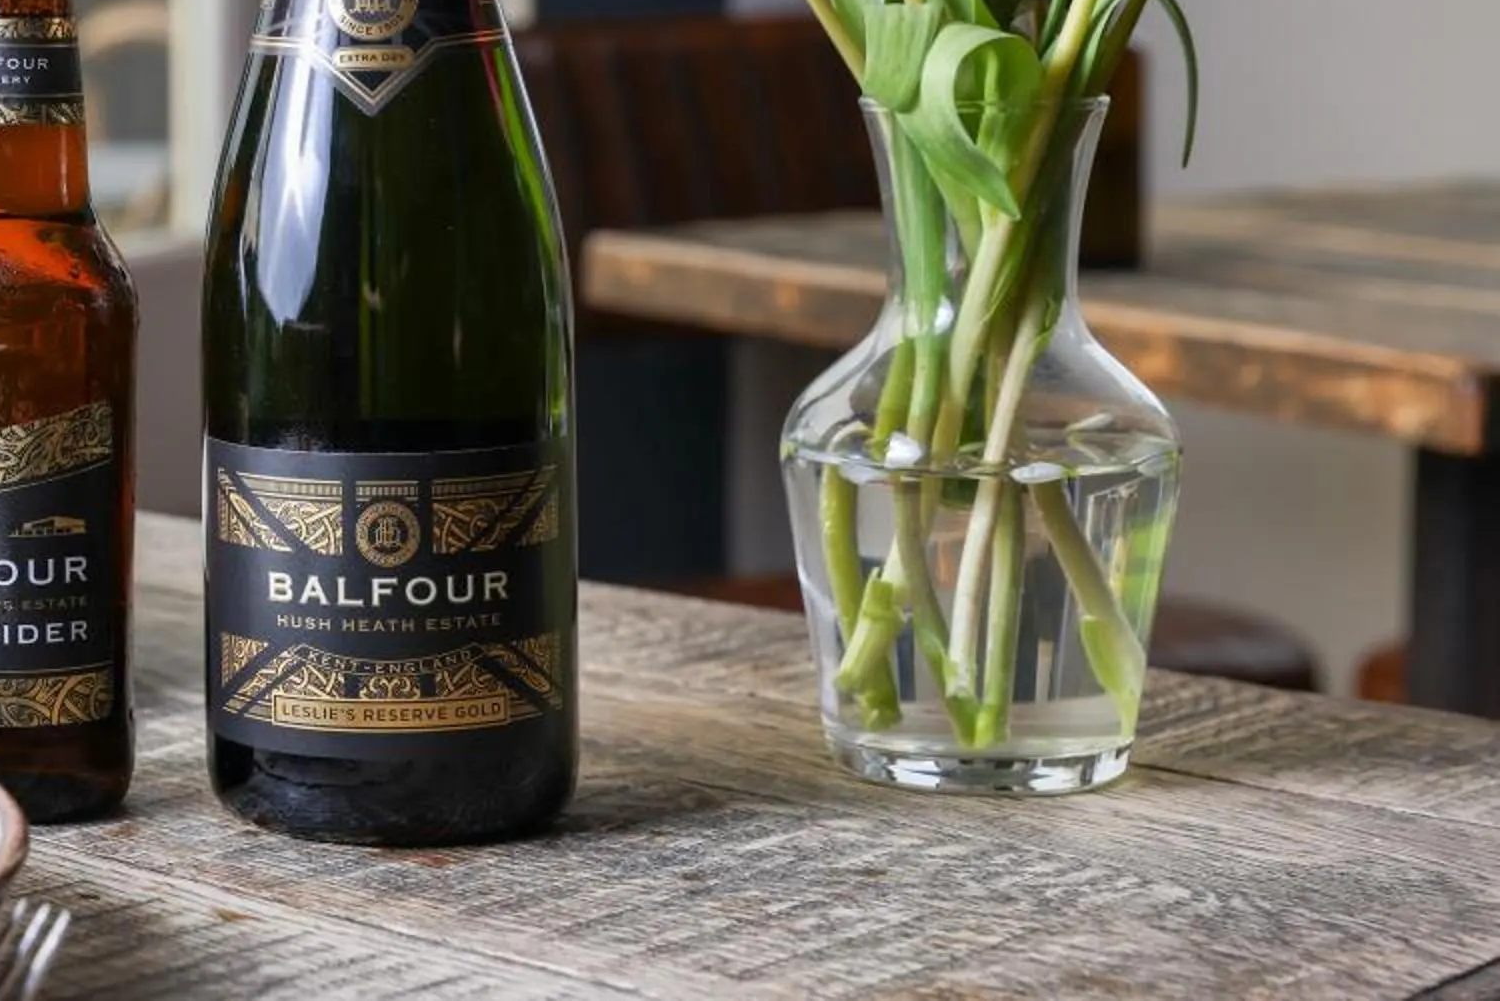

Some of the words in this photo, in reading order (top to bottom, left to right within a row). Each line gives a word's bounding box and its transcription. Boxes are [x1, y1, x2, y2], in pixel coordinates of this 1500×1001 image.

[268, 570, 509, 608] BALFOUR
[21, 595, 89, 611] ESTATE
[277, 613, 332, 631] HUSH
[342, 618, 416, 633] HEATH
[425, 612, 501, 632] ESTATE
[282, 703, 356, 721] LESLIE'S
[363, 706, 449, 722] RESERVE
[455, 701, 501, 719] GOLD
